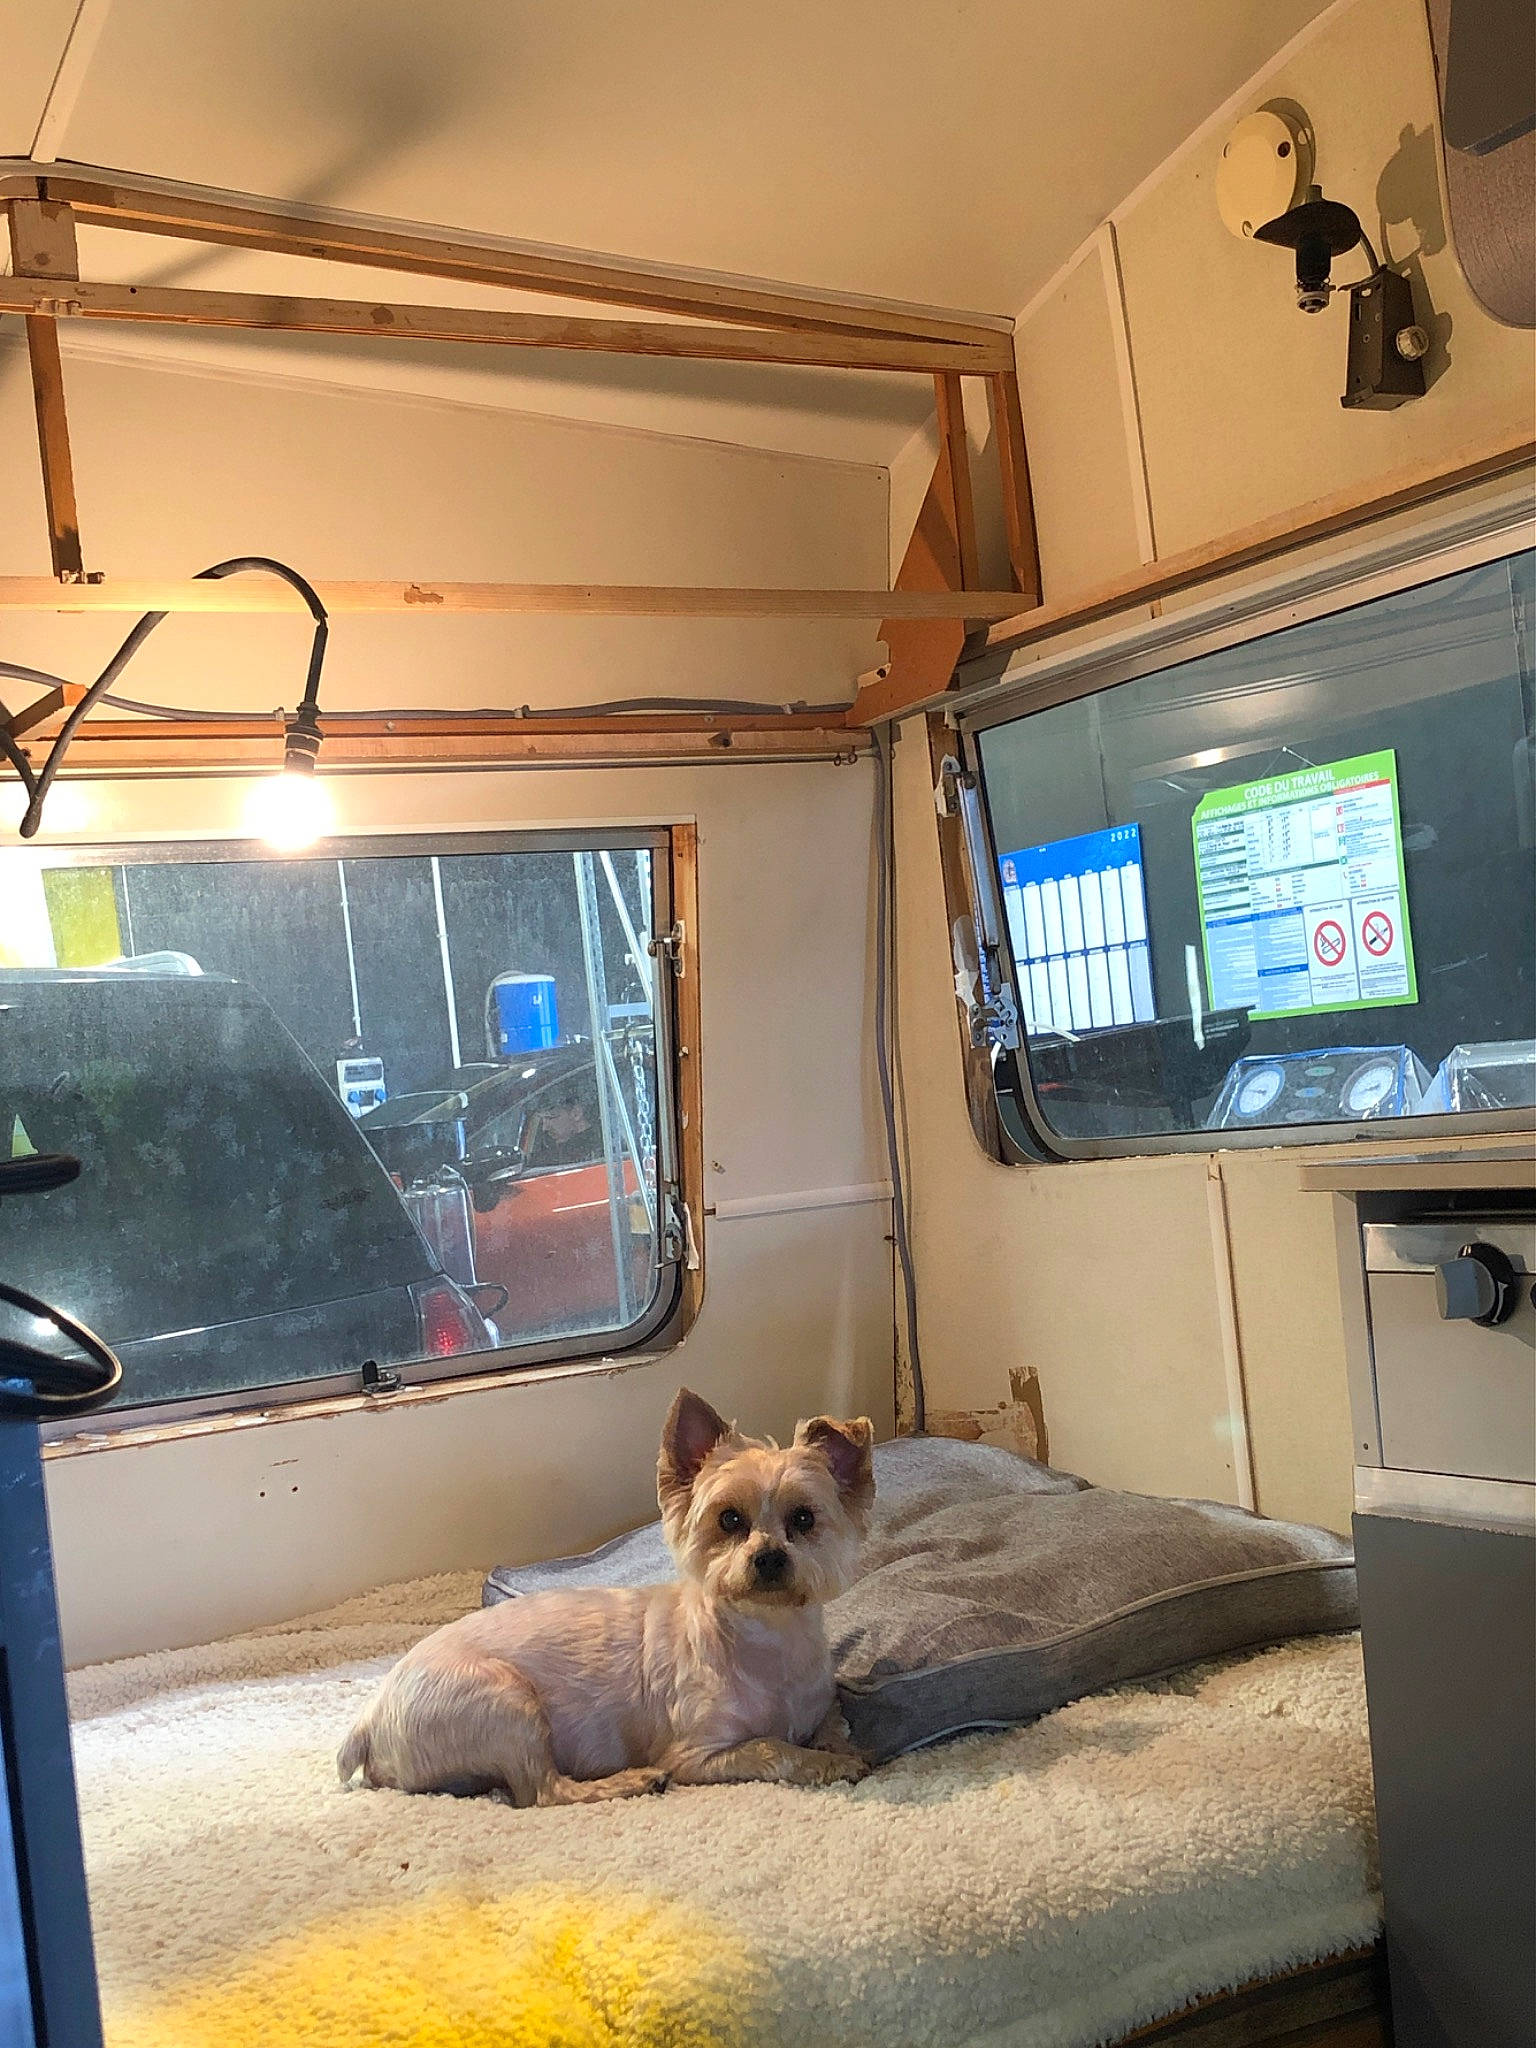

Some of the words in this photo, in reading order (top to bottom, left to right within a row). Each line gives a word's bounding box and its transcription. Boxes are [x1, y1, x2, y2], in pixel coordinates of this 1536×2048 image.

[1244, 783, 1272, 799] CODE
[1274, 779, 1290, 792] DU
[1291, 769, 1335, 789] TRAVAIL
[1319, 771, 1379, 791] OBLIGATOIRES
[1110, 828, 1137, 842] 2022
